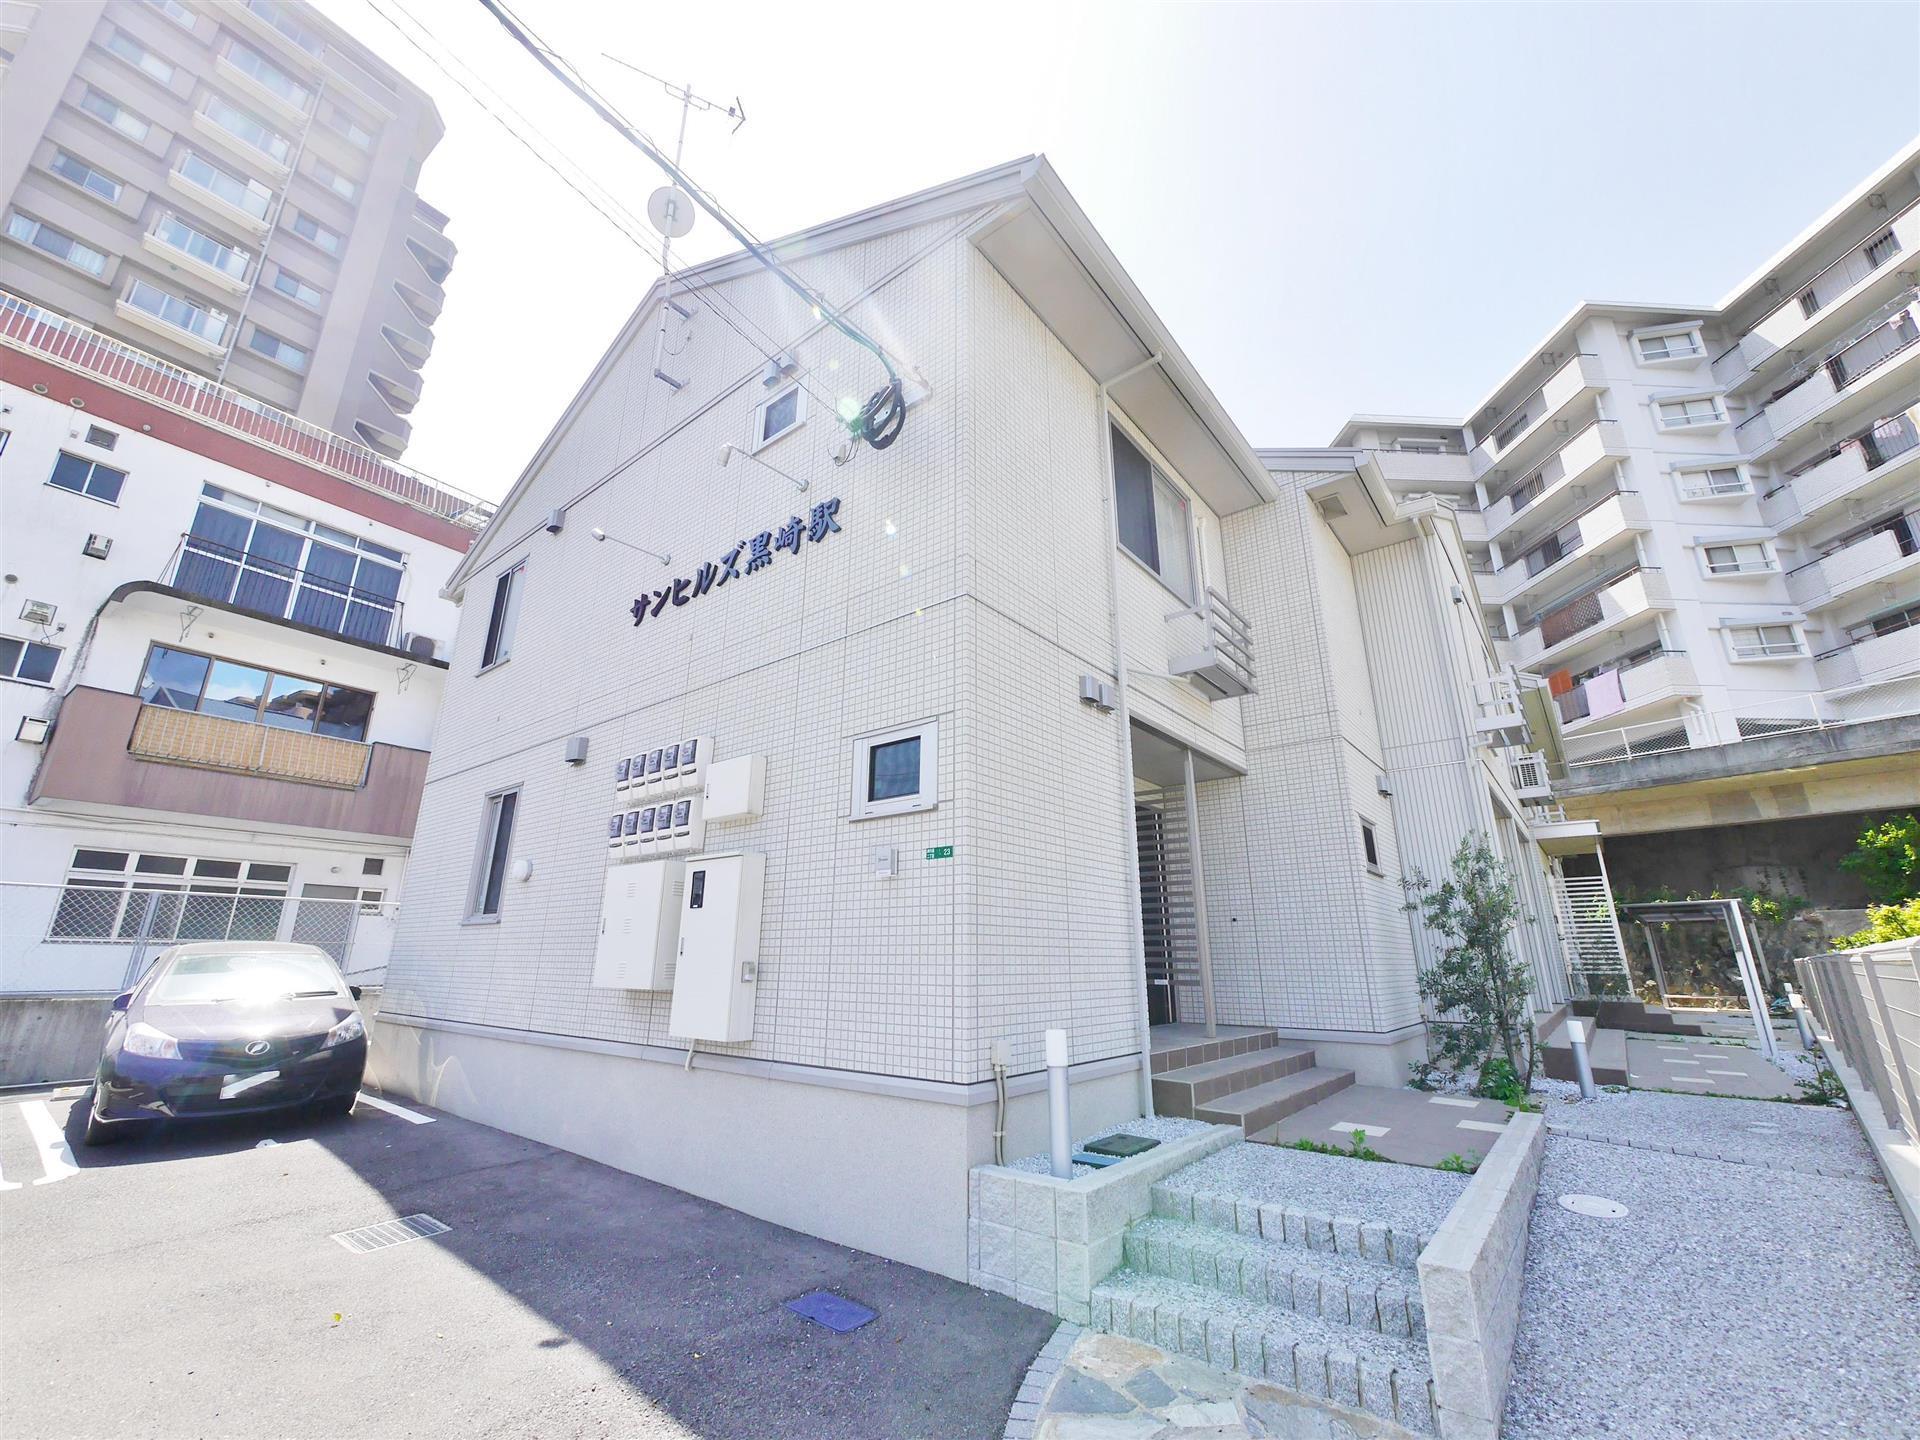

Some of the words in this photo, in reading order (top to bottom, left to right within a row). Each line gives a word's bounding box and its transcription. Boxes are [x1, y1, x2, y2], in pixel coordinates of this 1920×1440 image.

[630, 497, 842, 626] サンヒルズ黒崎駅
